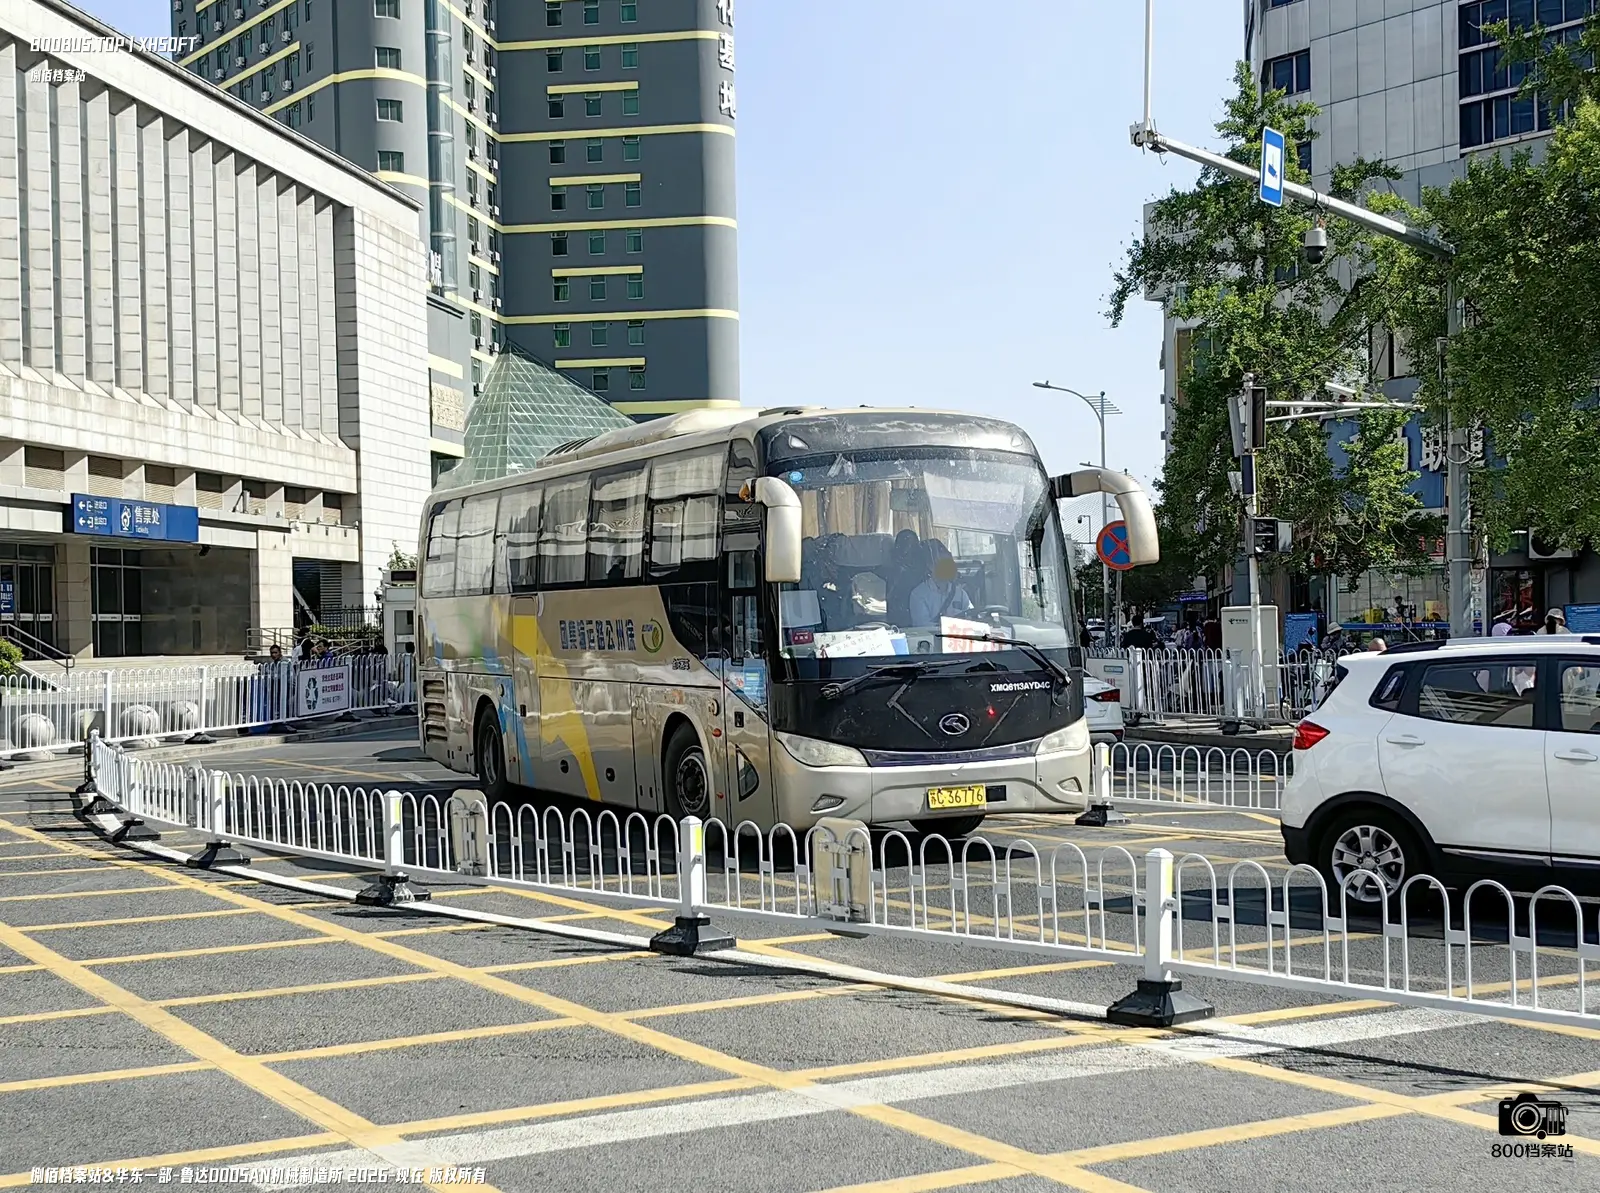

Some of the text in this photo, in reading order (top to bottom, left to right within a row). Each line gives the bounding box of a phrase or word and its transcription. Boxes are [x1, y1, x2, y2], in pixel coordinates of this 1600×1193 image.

[134, 505, 160, 525] 售票处
[990, 681, 1051, 693] XMQ6113AYD4C
